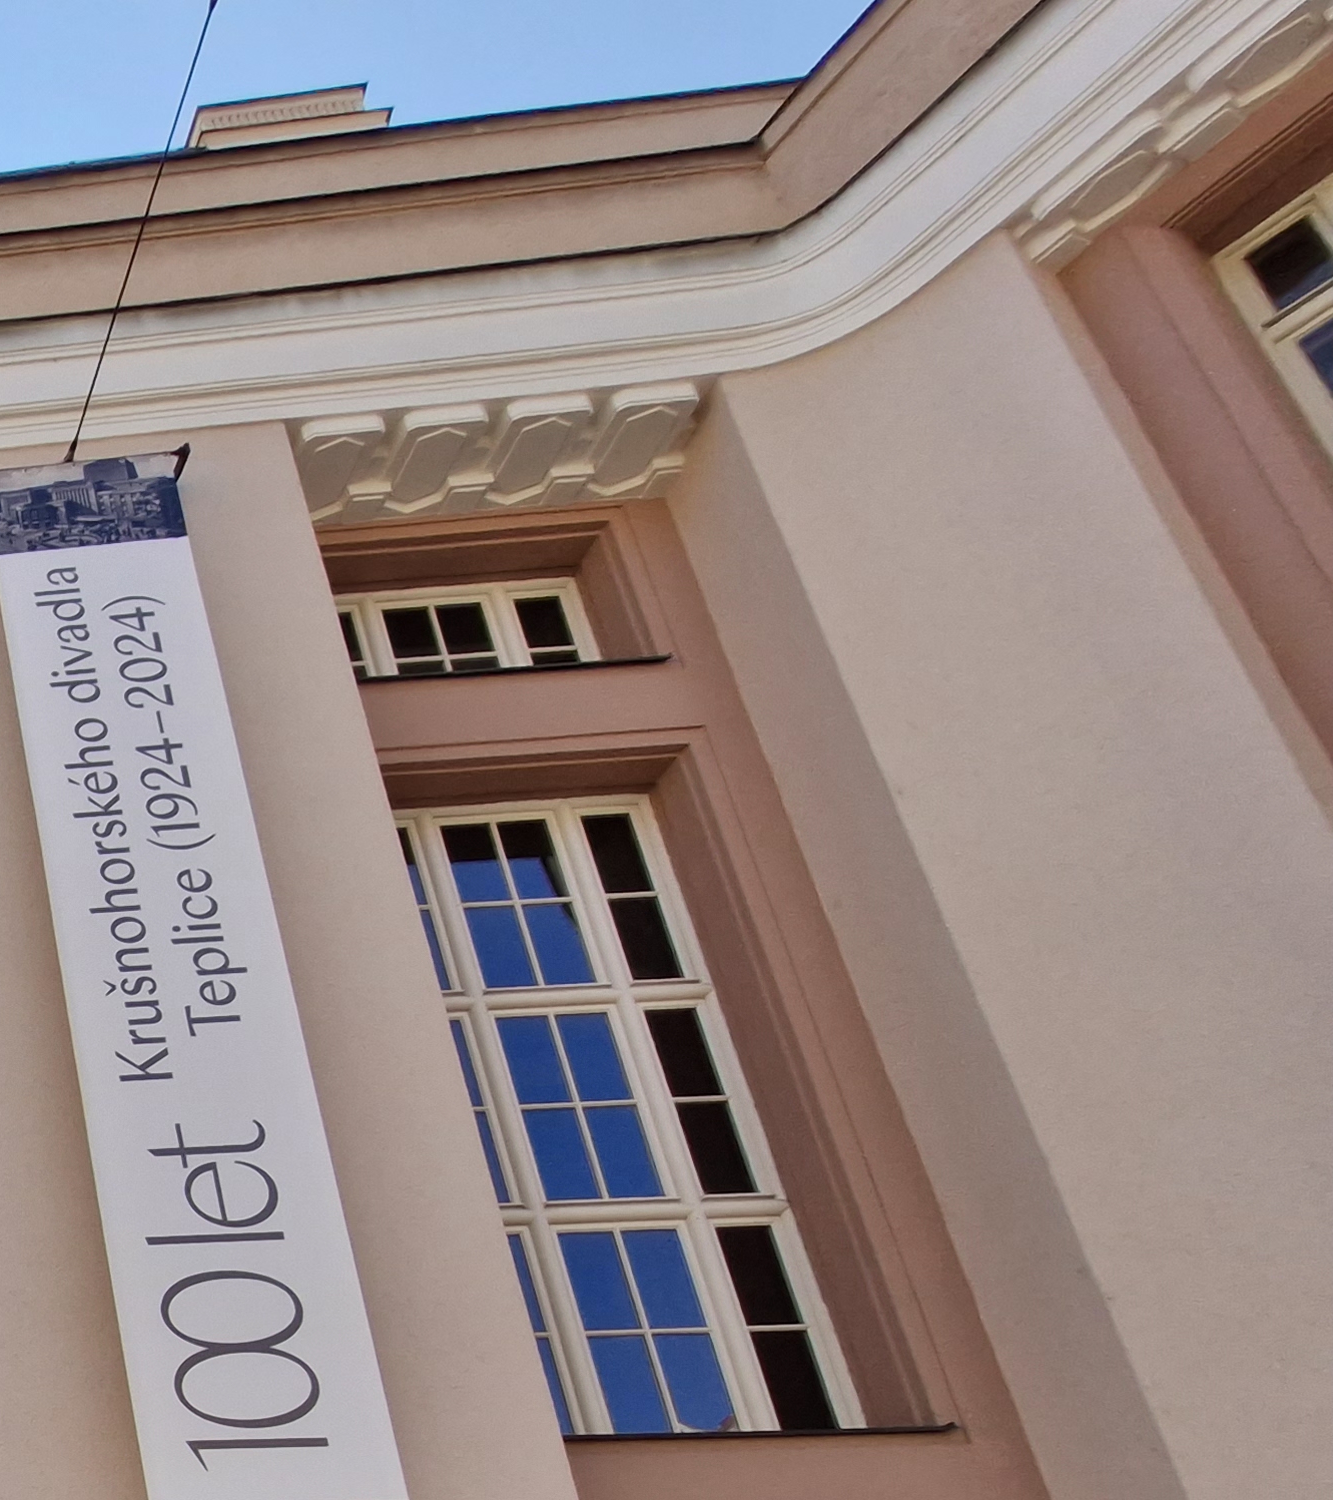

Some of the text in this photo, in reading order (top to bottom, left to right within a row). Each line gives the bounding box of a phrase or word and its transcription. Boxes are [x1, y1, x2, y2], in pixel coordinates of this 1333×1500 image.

[34, 565, 174, 1082] Krušnohorského divadla
[171, 867, 248, 1037] Teplice
[145, 1119, 329, 1472] 100 let
